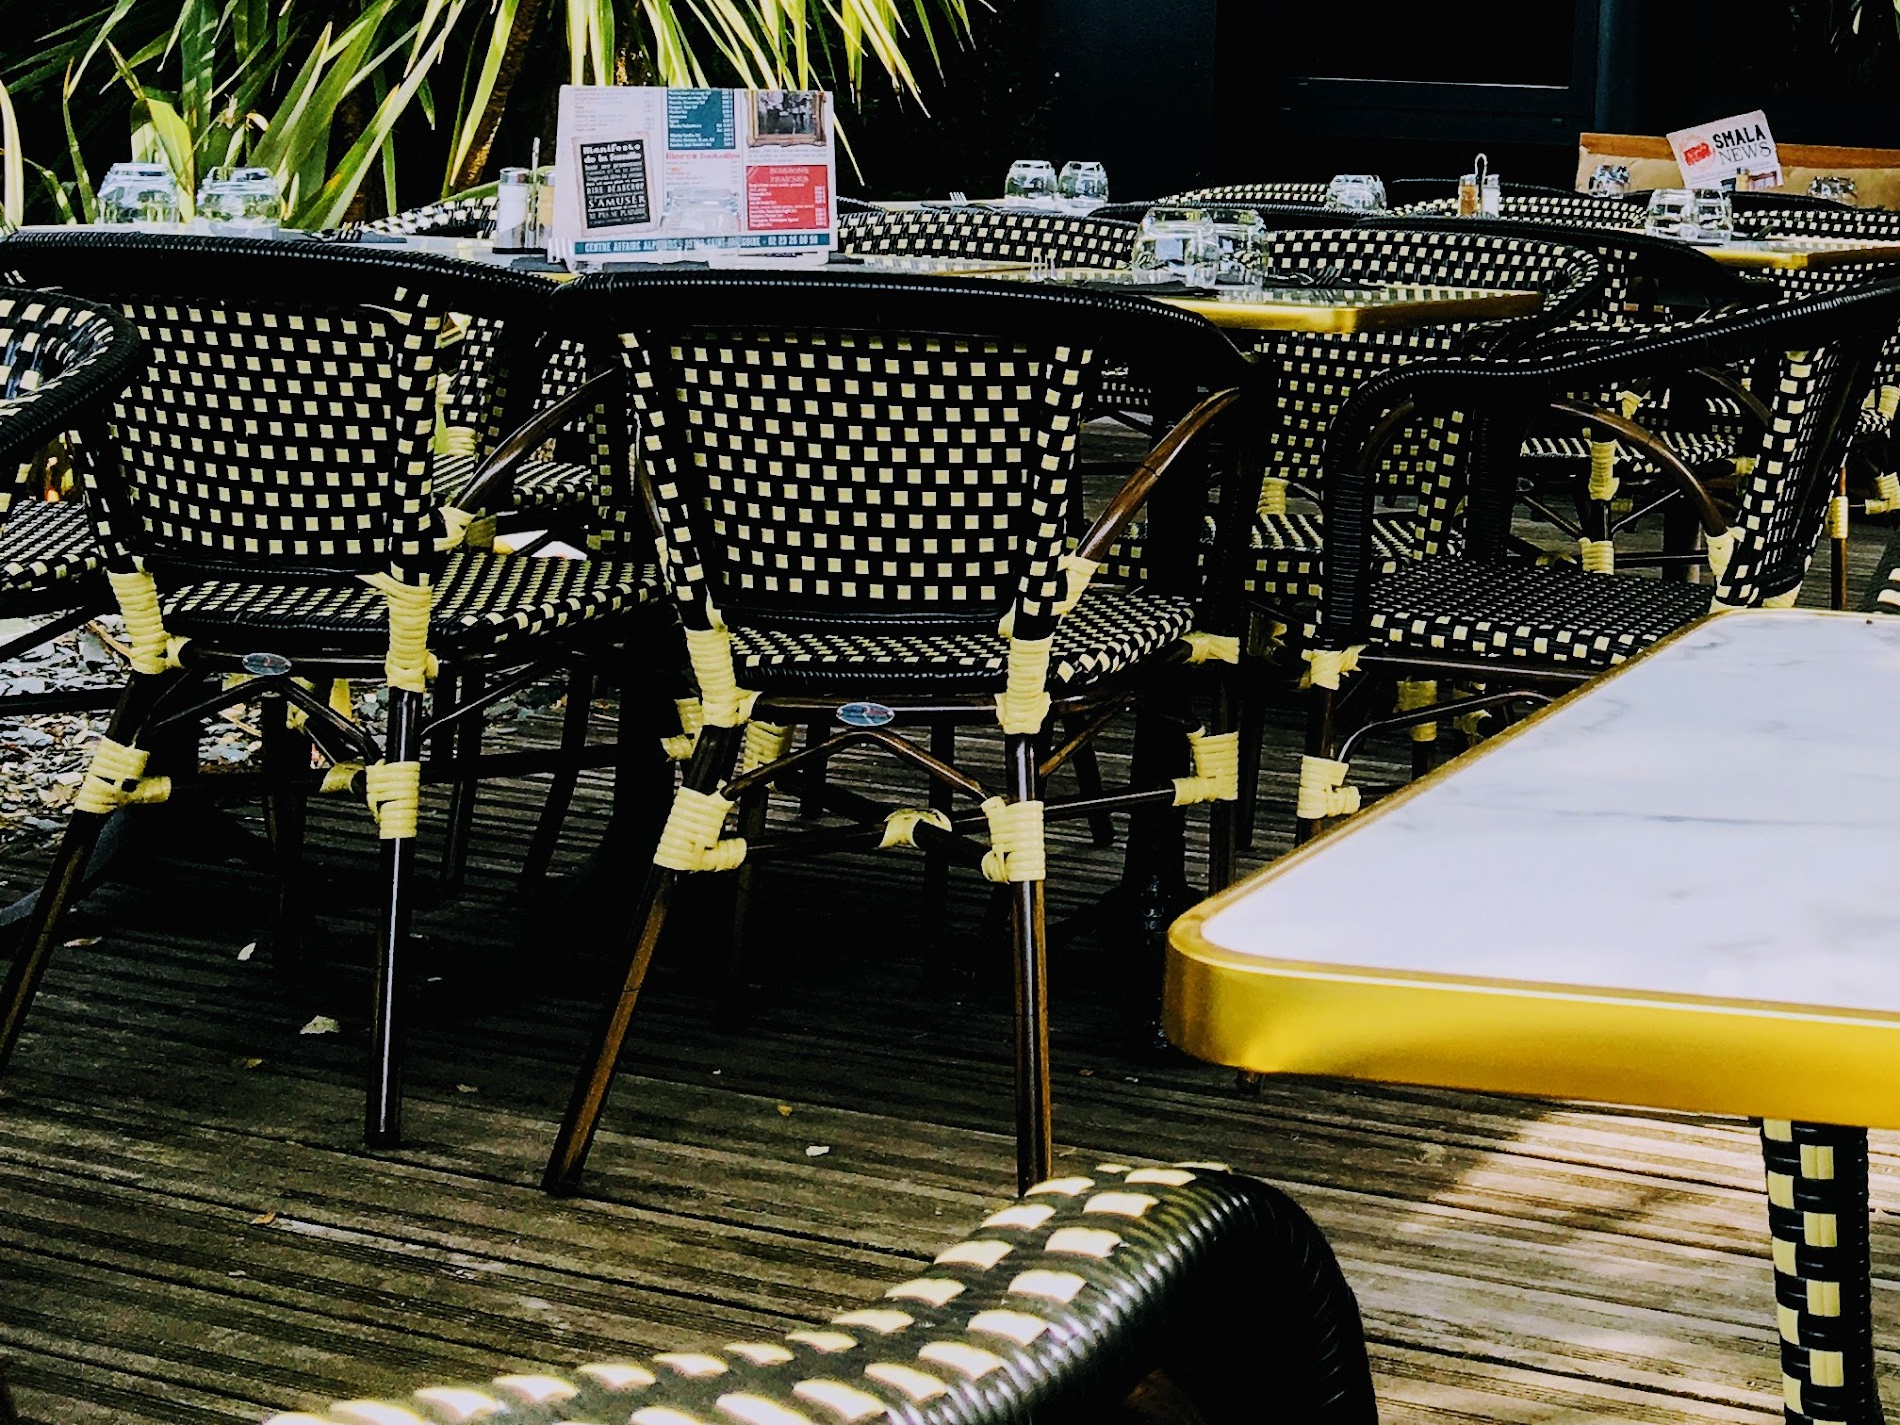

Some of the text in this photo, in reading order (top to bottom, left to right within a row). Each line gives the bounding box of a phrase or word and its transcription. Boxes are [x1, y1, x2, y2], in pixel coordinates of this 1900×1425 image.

[1712, 124, 1766, 149] SMALA
[583, 143, 641, 155] Manifesto
[1719, 141, 1771, 164] NEWS
[589, 196, 645, 208] S'AMUSER
[585, 242, 610, 253] CENTRE
